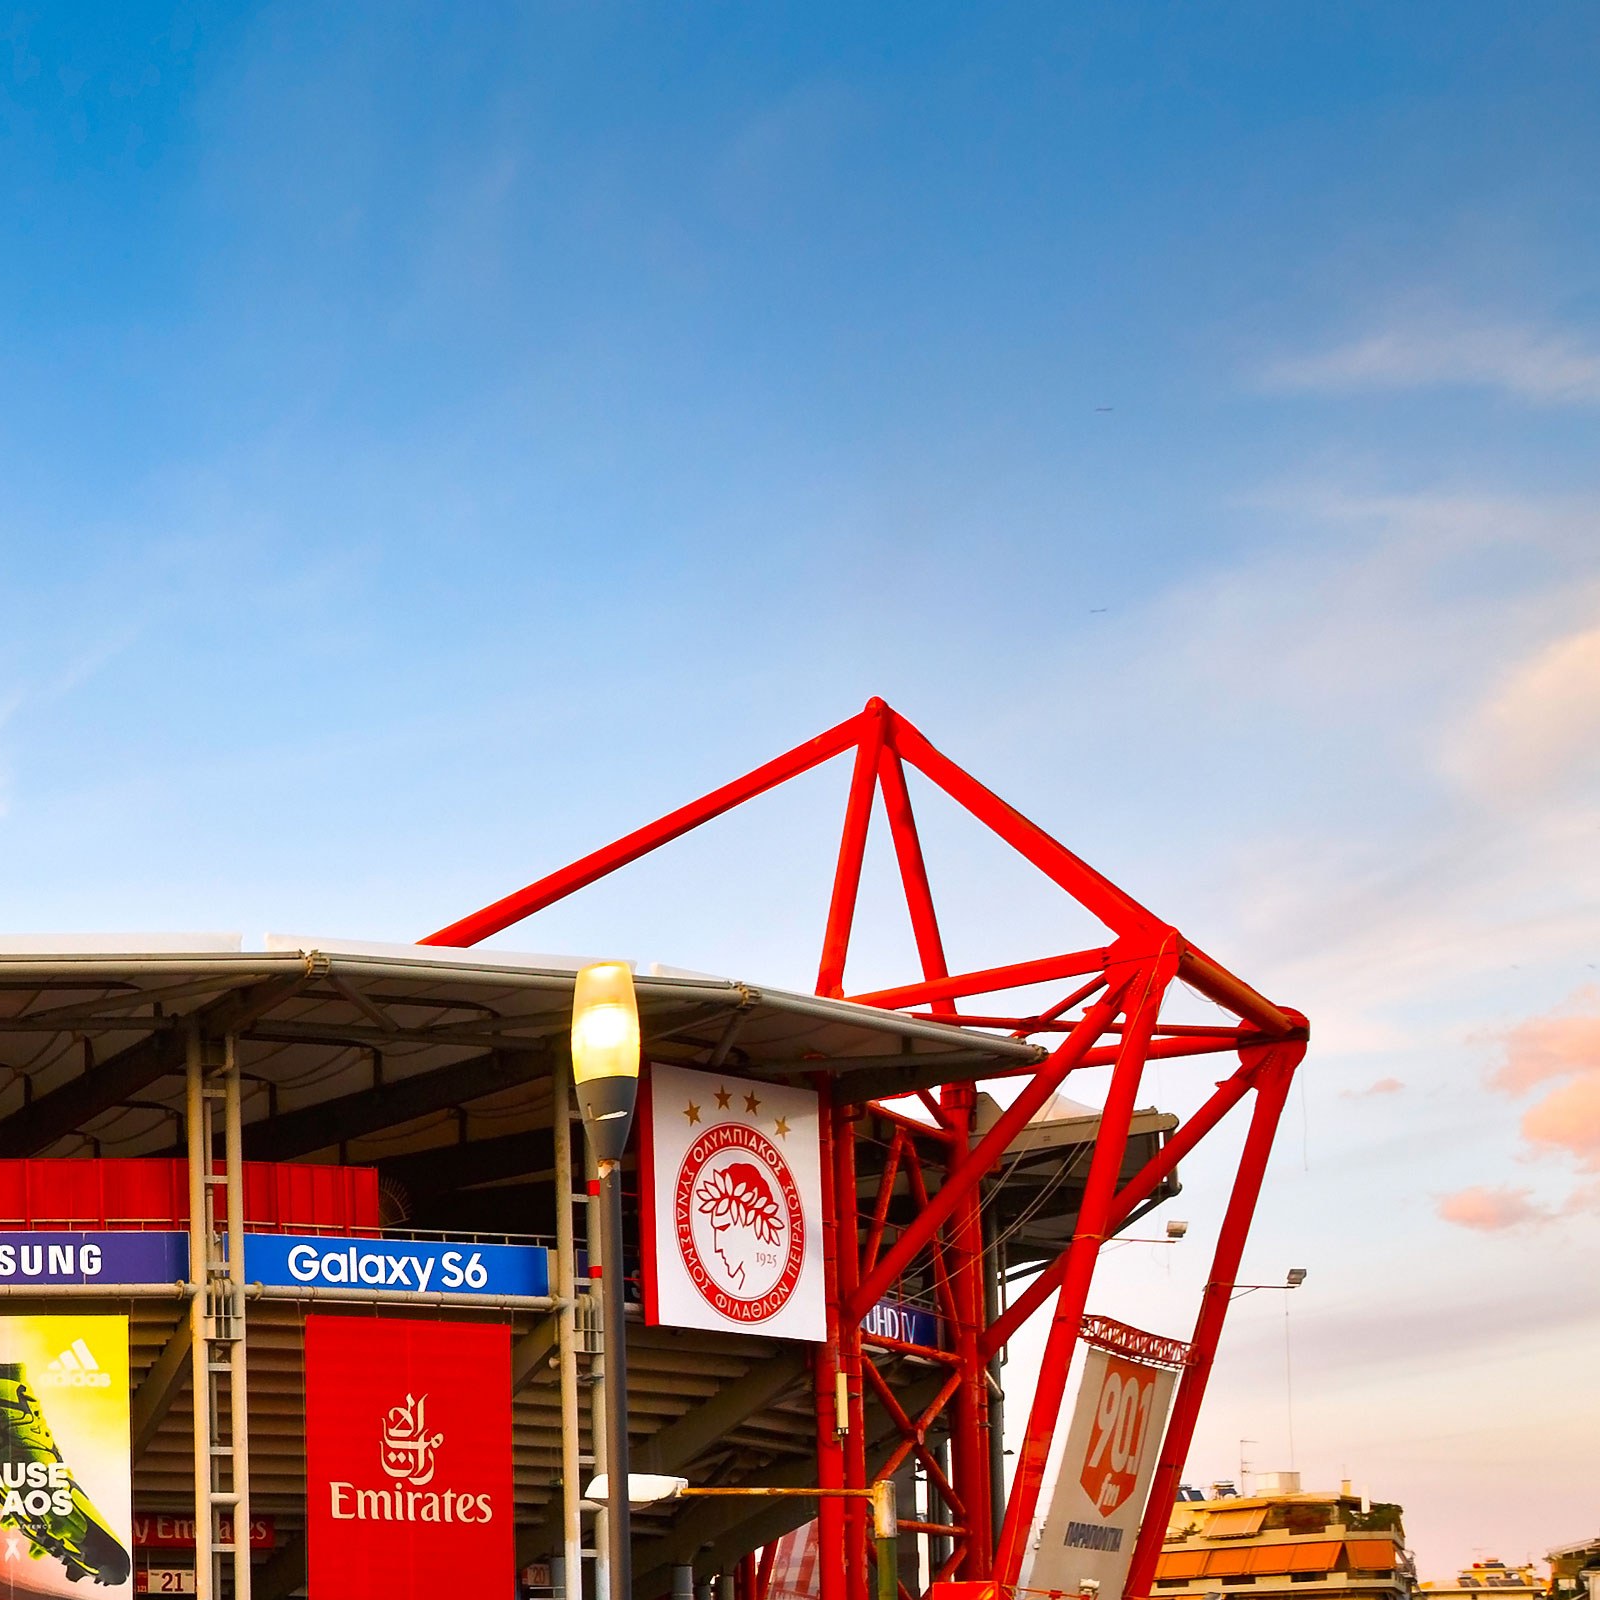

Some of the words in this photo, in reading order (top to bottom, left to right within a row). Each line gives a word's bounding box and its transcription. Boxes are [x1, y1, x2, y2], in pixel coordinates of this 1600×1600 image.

[693, 1128, 784, 1176] ΟΛΥΜΠΙΑΚΟΣ
[677, 1166, 712, 1294] ΣΥΝΔΕΣΜΟΣ
[783, 1180, 803, 1279] ΠΕΙΡΑΙΩΣ
[287, 1244, 435, 1292] Galaxy
[441, 1252, 488, 1288] S6
[755, 1251, 777, 1268] 1925
[715, 1281, 789, 1319] ΦΙΛΑΘΛΩΝ
[38, 1372, 112, 1388] adidas
[329, 1482, 493, 1524] Emirates
[1099, 1472, 1120, 1507] fm
[161, 1572, 184, 1592] 21
